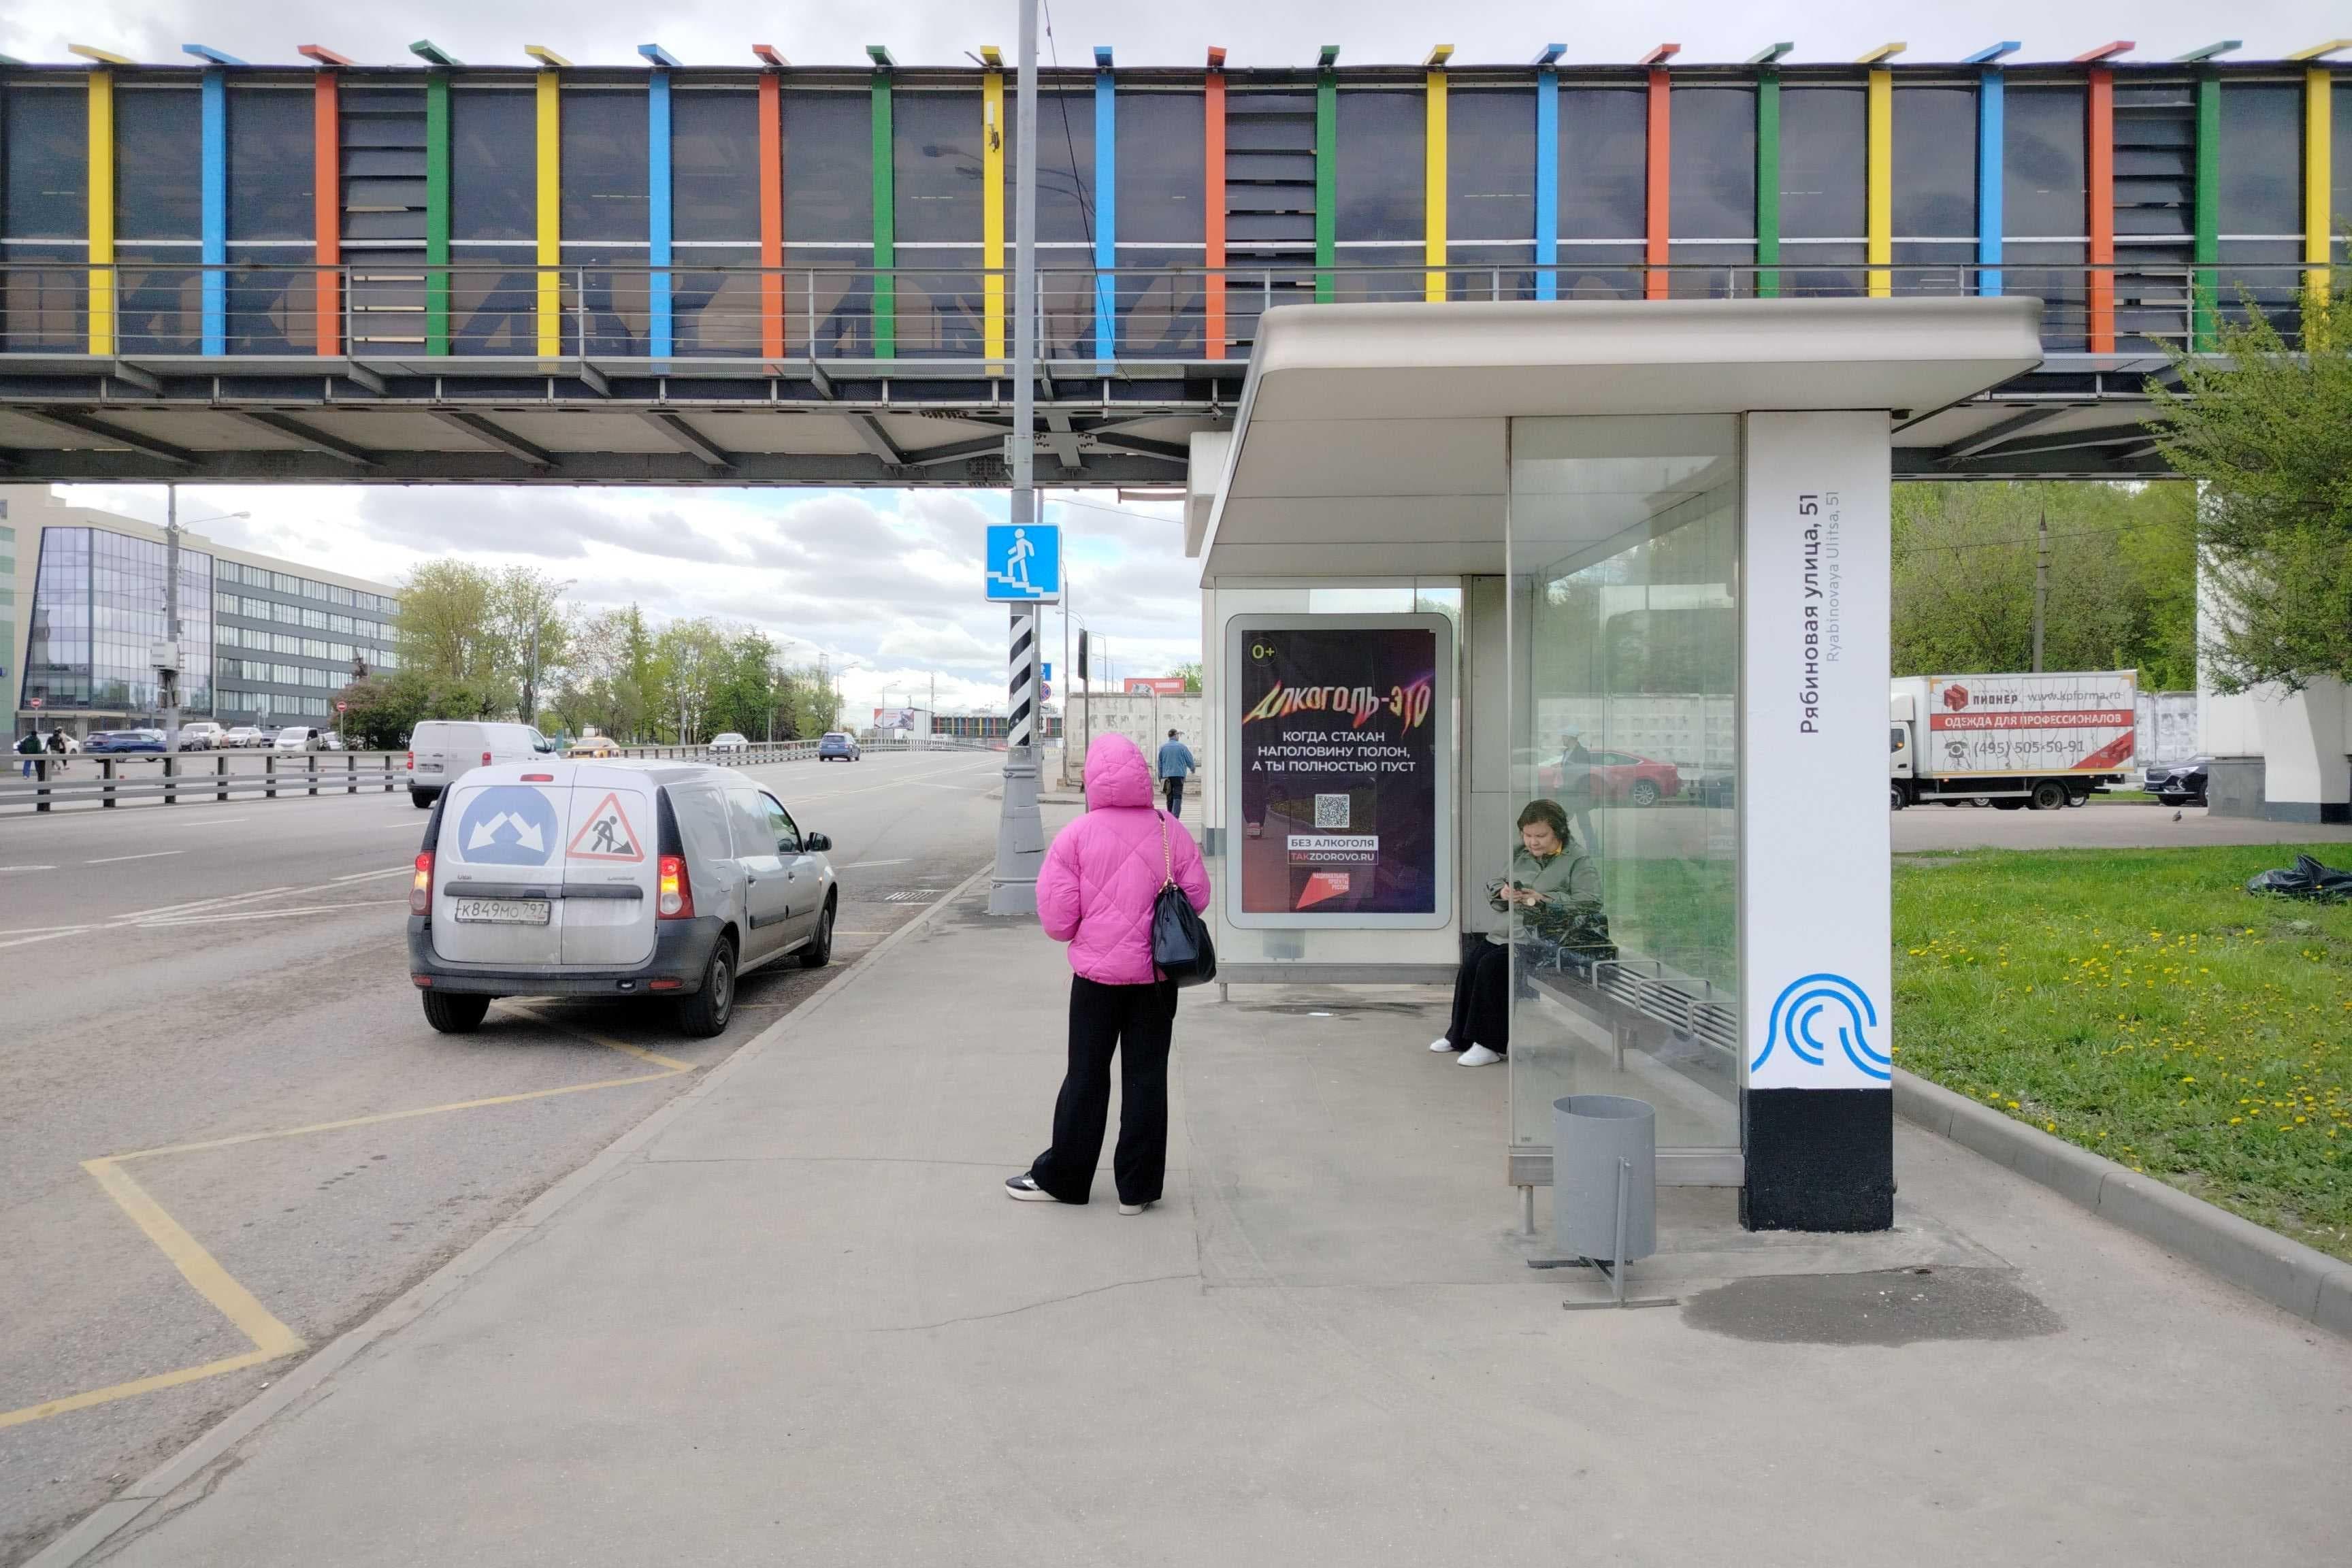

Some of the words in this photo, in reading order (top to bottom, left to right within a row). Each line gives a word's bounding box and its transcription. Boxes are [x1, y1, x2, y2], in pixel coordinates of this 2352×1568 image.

[1800, 494, 1818, 516] 51
[1826, 491, 1839, 506] 51
[1826, 510, 1840, 559] Ulitsa,
[1804, 523, 1823, 599] улица,
[1826, 564, 1842, 662] Ryabinovaya
[1252, 644, 1275, 659] 0+
[1800, 606, 1819, 734] Рябиновая
[1973, 695, 2018, 705] ПИОНЕР
[1944, 717, 1993, 728] ОДЕЖДА
[1995, 716, 2017, 728] ДЛЯ
[2021, 714, 2122, 725] ПРОФЕССИОНАЛОВ
[1283, 732, 1327, 743] КОГДА
[1331, 732, 1385, 742] СТАКАН
[1258, 747, 1354, 757] НАПОЛОВИНУ
[1358, 747, 1410, 759] ПОЛОН,
[1974, 741, 2010, 757] (495)
[2014, 740, 2085, 753] 505-50-91
[1252, 762, 1262, 771] А
[1265, 762, 1285, 771] ТЫ
[1289, 762, 1377, 772] ПОЛНОСТЬЮ
[1381, 762, 1416, 772] ПУСТ
[1314, 839, 1374, 847] АЛКОГОЛЯ
[1290, 853, 1375, 861] TAKZDOROVO.RU
